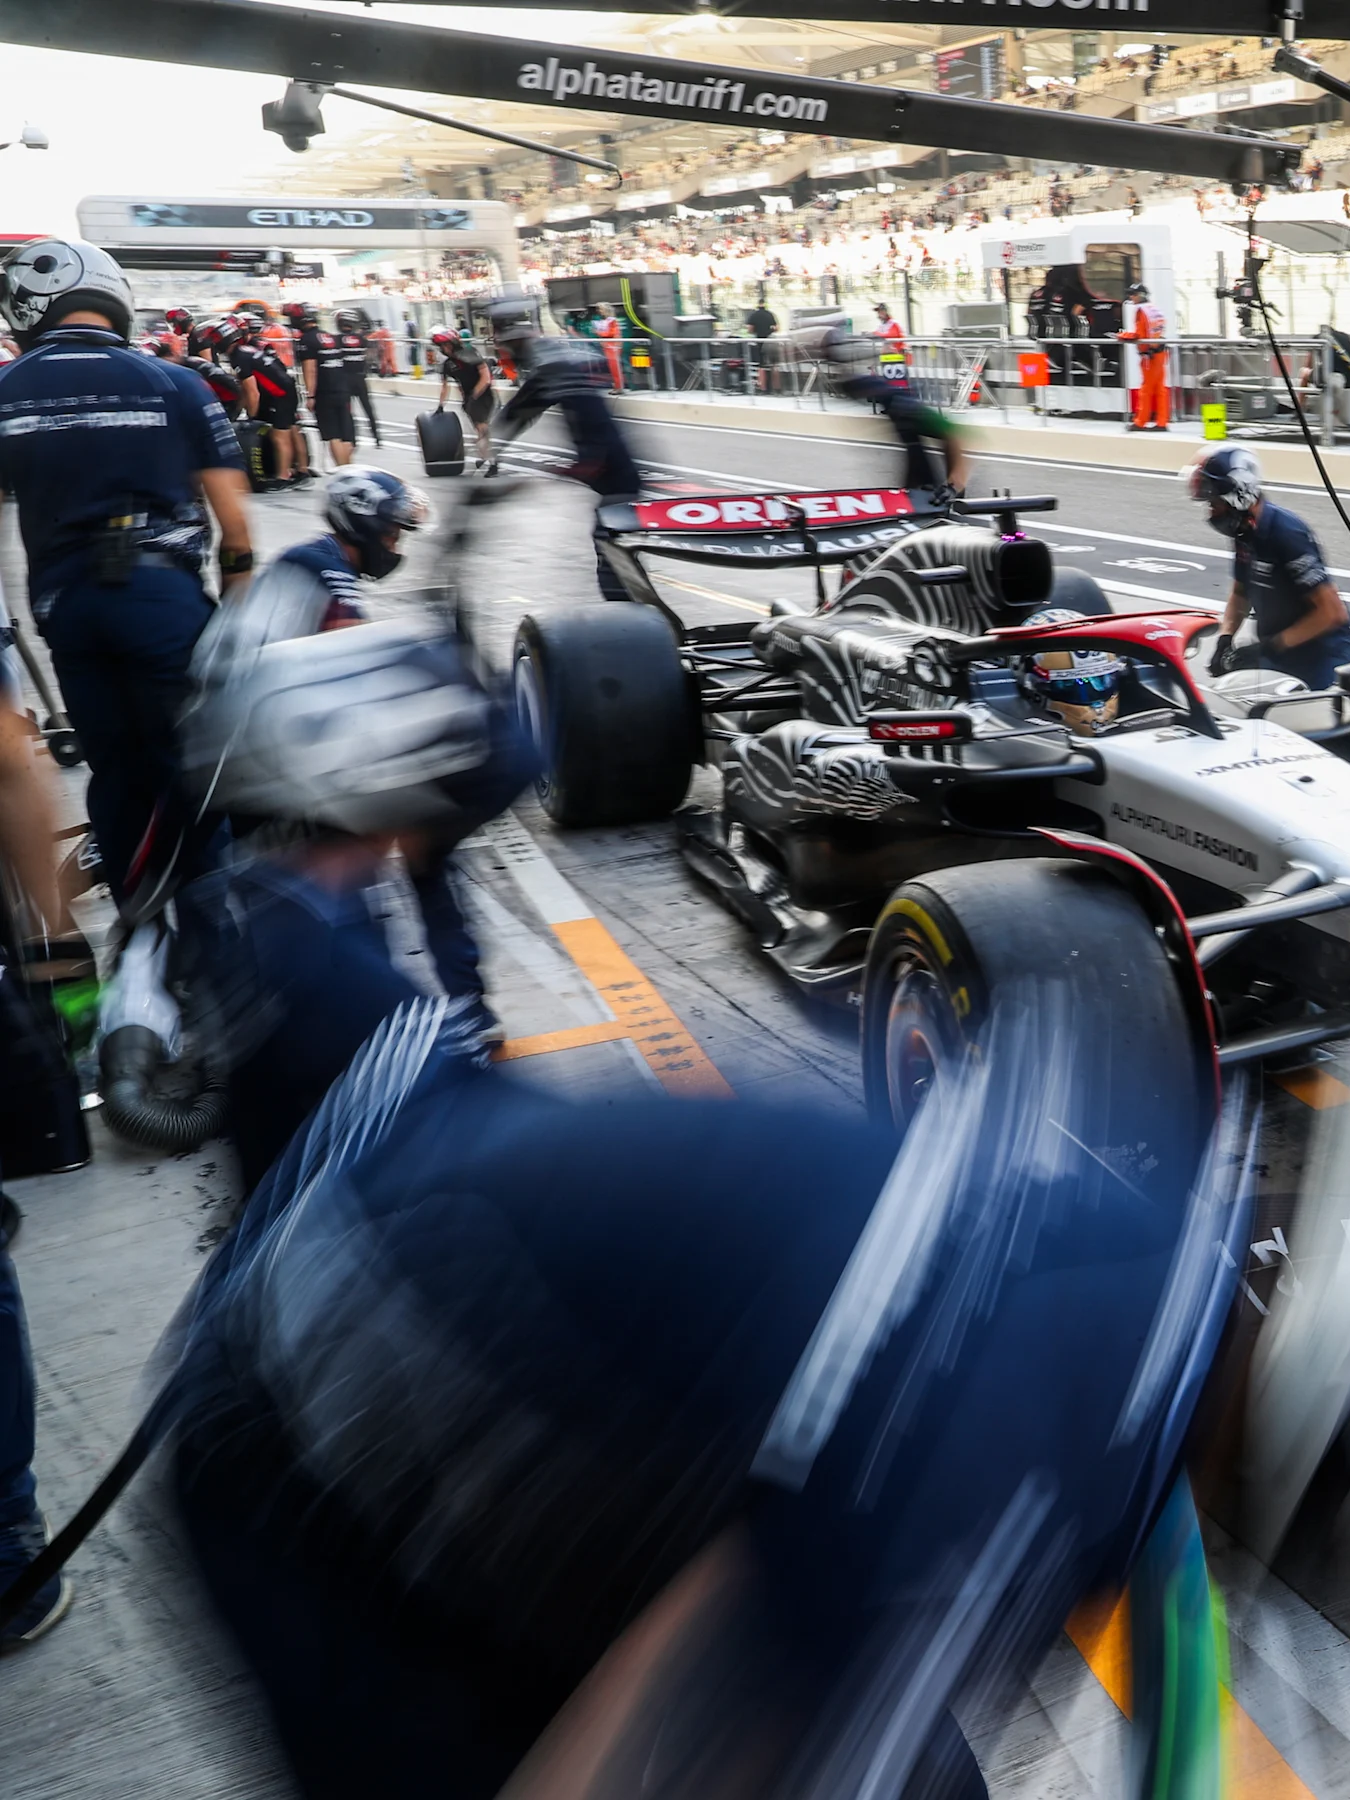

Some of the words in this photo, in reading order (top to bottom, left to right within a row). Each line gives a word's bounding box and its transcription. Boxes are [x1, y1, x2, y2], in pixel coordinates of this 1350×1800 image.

[517, 57, 829, 122] alphataurif1.com
[247, 208, 374, 228] ETIHAD
[896, 726, 940, 737] ORLEN
[1110, 802, 1259, 872] ALPHATAURI.FASHION
